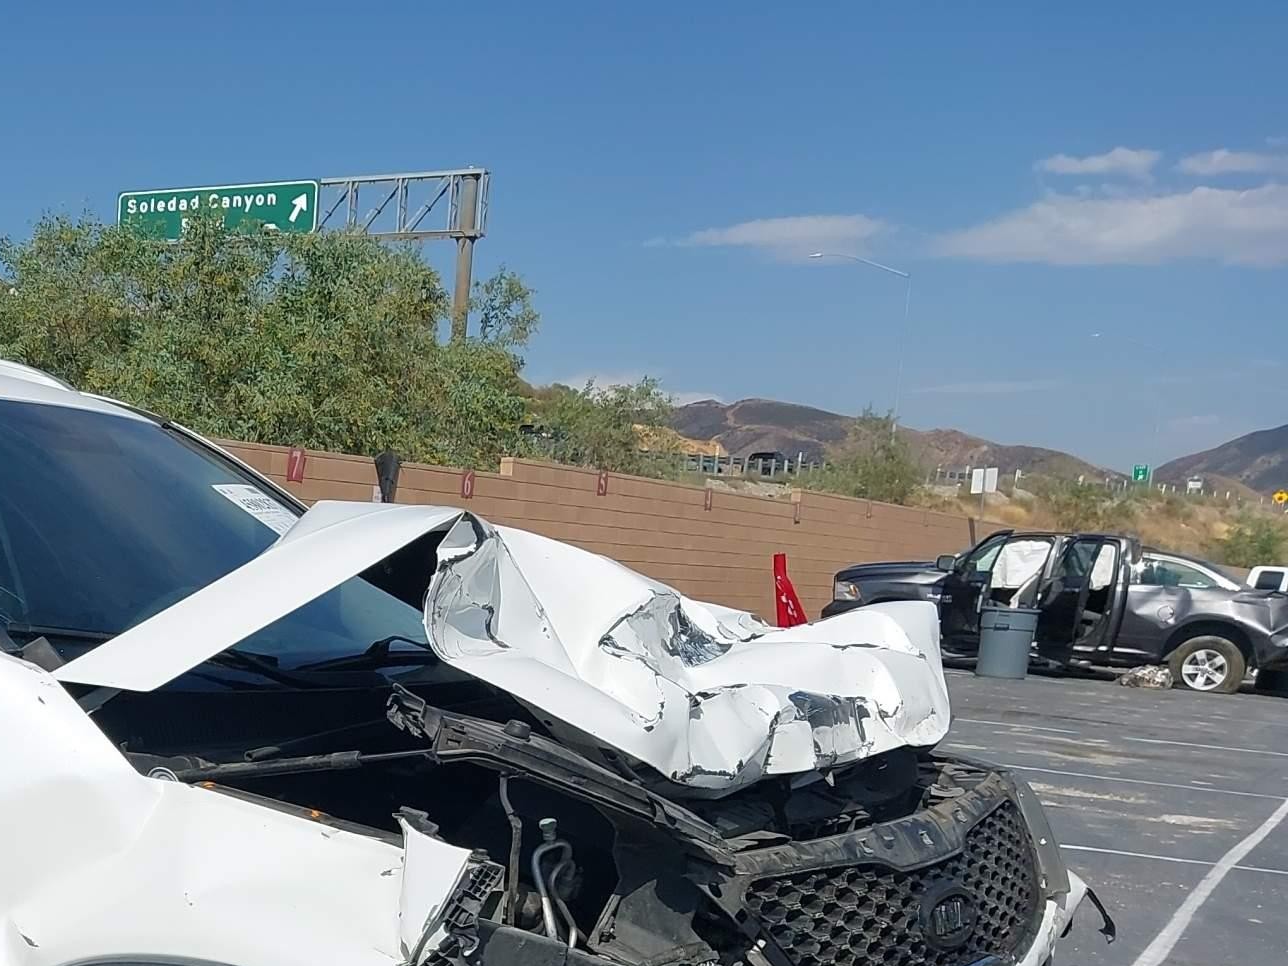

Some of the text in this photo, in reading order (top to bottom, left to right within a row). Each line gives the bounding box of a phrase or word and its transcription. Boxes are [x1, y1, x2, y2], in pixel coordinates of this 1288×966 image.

[127, 193, 277, 213] Soledad Canyon
[292, 450, 302, 479] 7
[464, 471, 472, 496] 6
